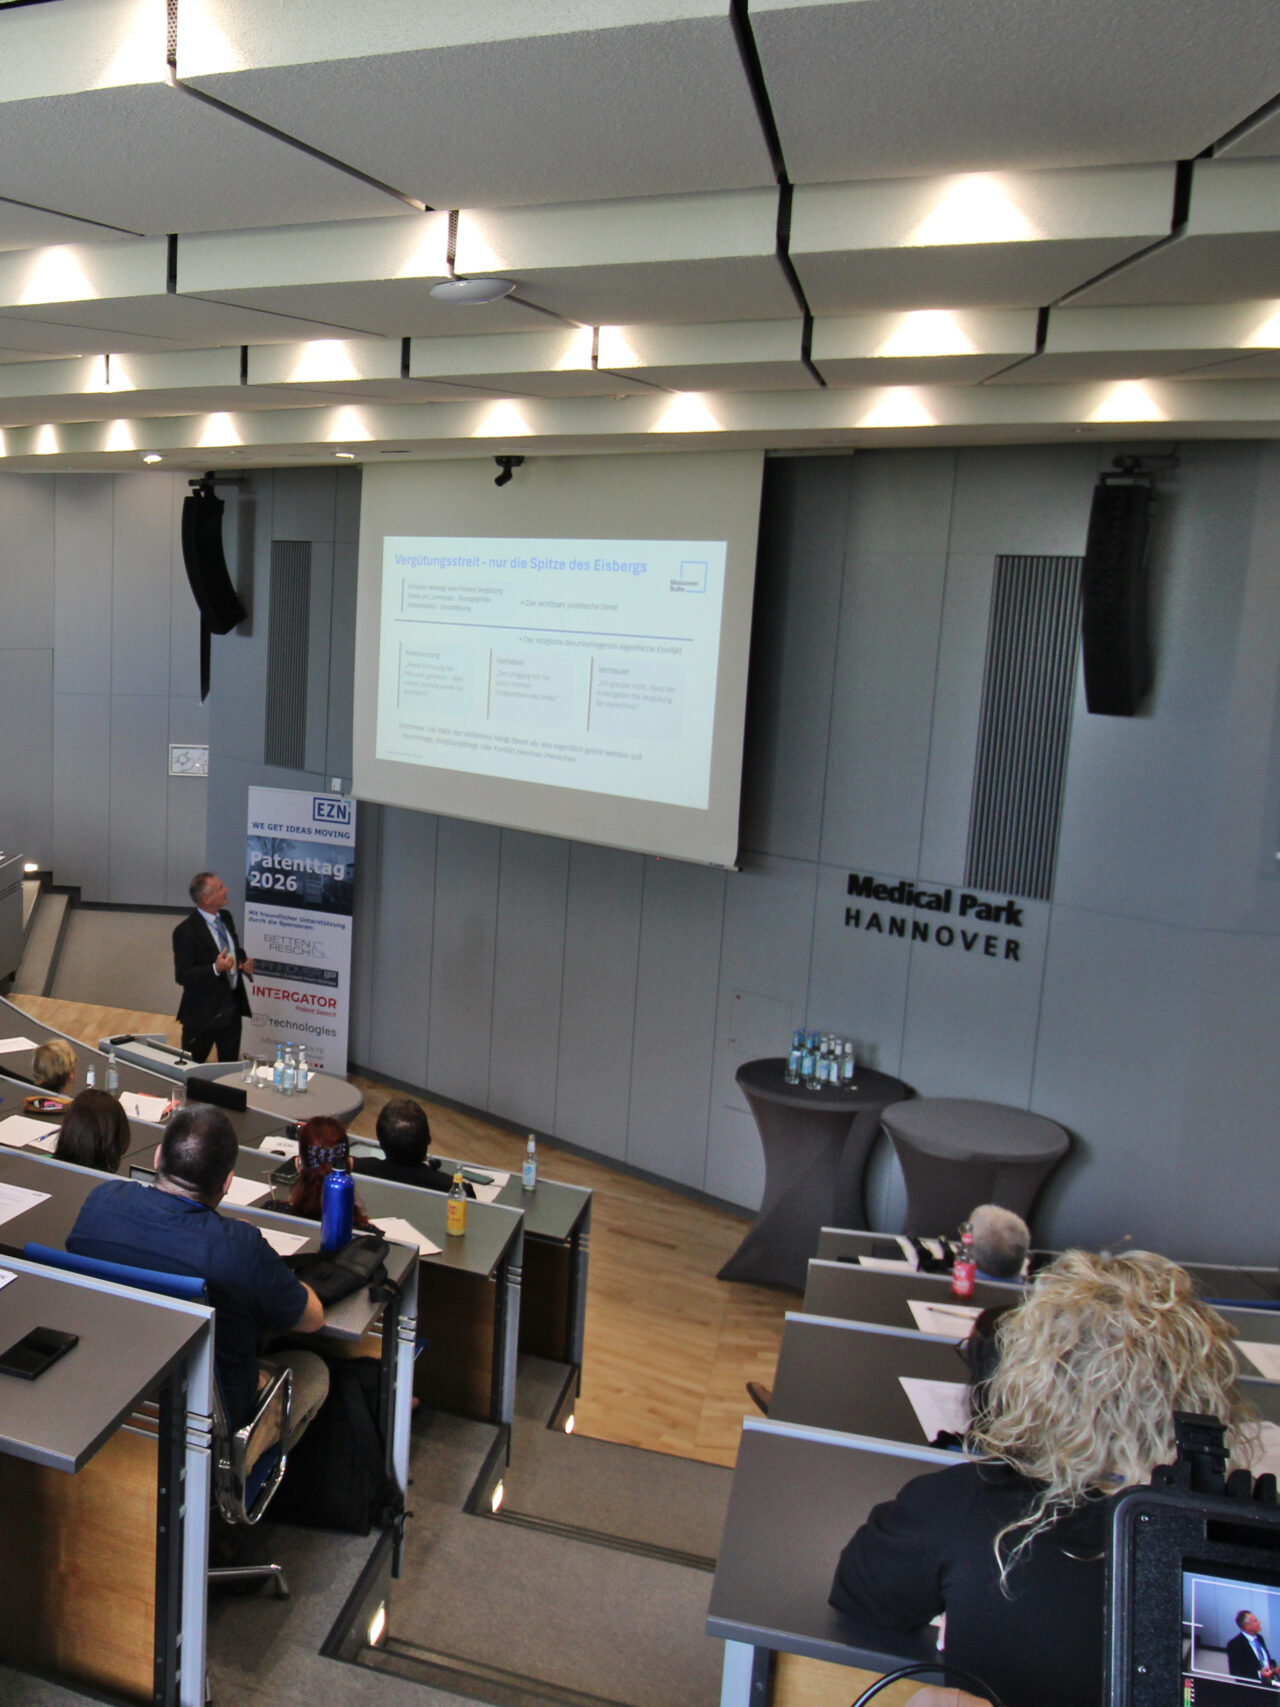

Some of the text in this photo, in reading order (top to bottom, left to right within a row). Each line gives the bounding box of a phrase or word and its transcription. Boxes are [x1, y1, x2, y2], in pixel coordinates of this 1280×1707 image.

[394, 554, 480, 569] Vergütungsstreit
[489, 558, 508, 568] nur
[510, 557, 528, 568] die
[530, 557, 566, 572] Spitze
[569, 558, 591, 571] des
[593, 559, 648, 575] Eisbergs
[317, 802, 347, 820] EZN
[252, 822, 351, 840] WE GET IDEAS MOVING
[250, 851, 345, 880] Patenttag
[250, 871, 298, 892] 2026
[847, 873, 1024, 927] Medical Park
[260, 911, 298, 922] freundlicher
[299, 917, 346, 930] Unterstützung
[264, 933, 312, 948] BETTEN
[845, 907, 1021, 962] HANNOVER
[252, 985, 337, 1009] INTERGATOR
